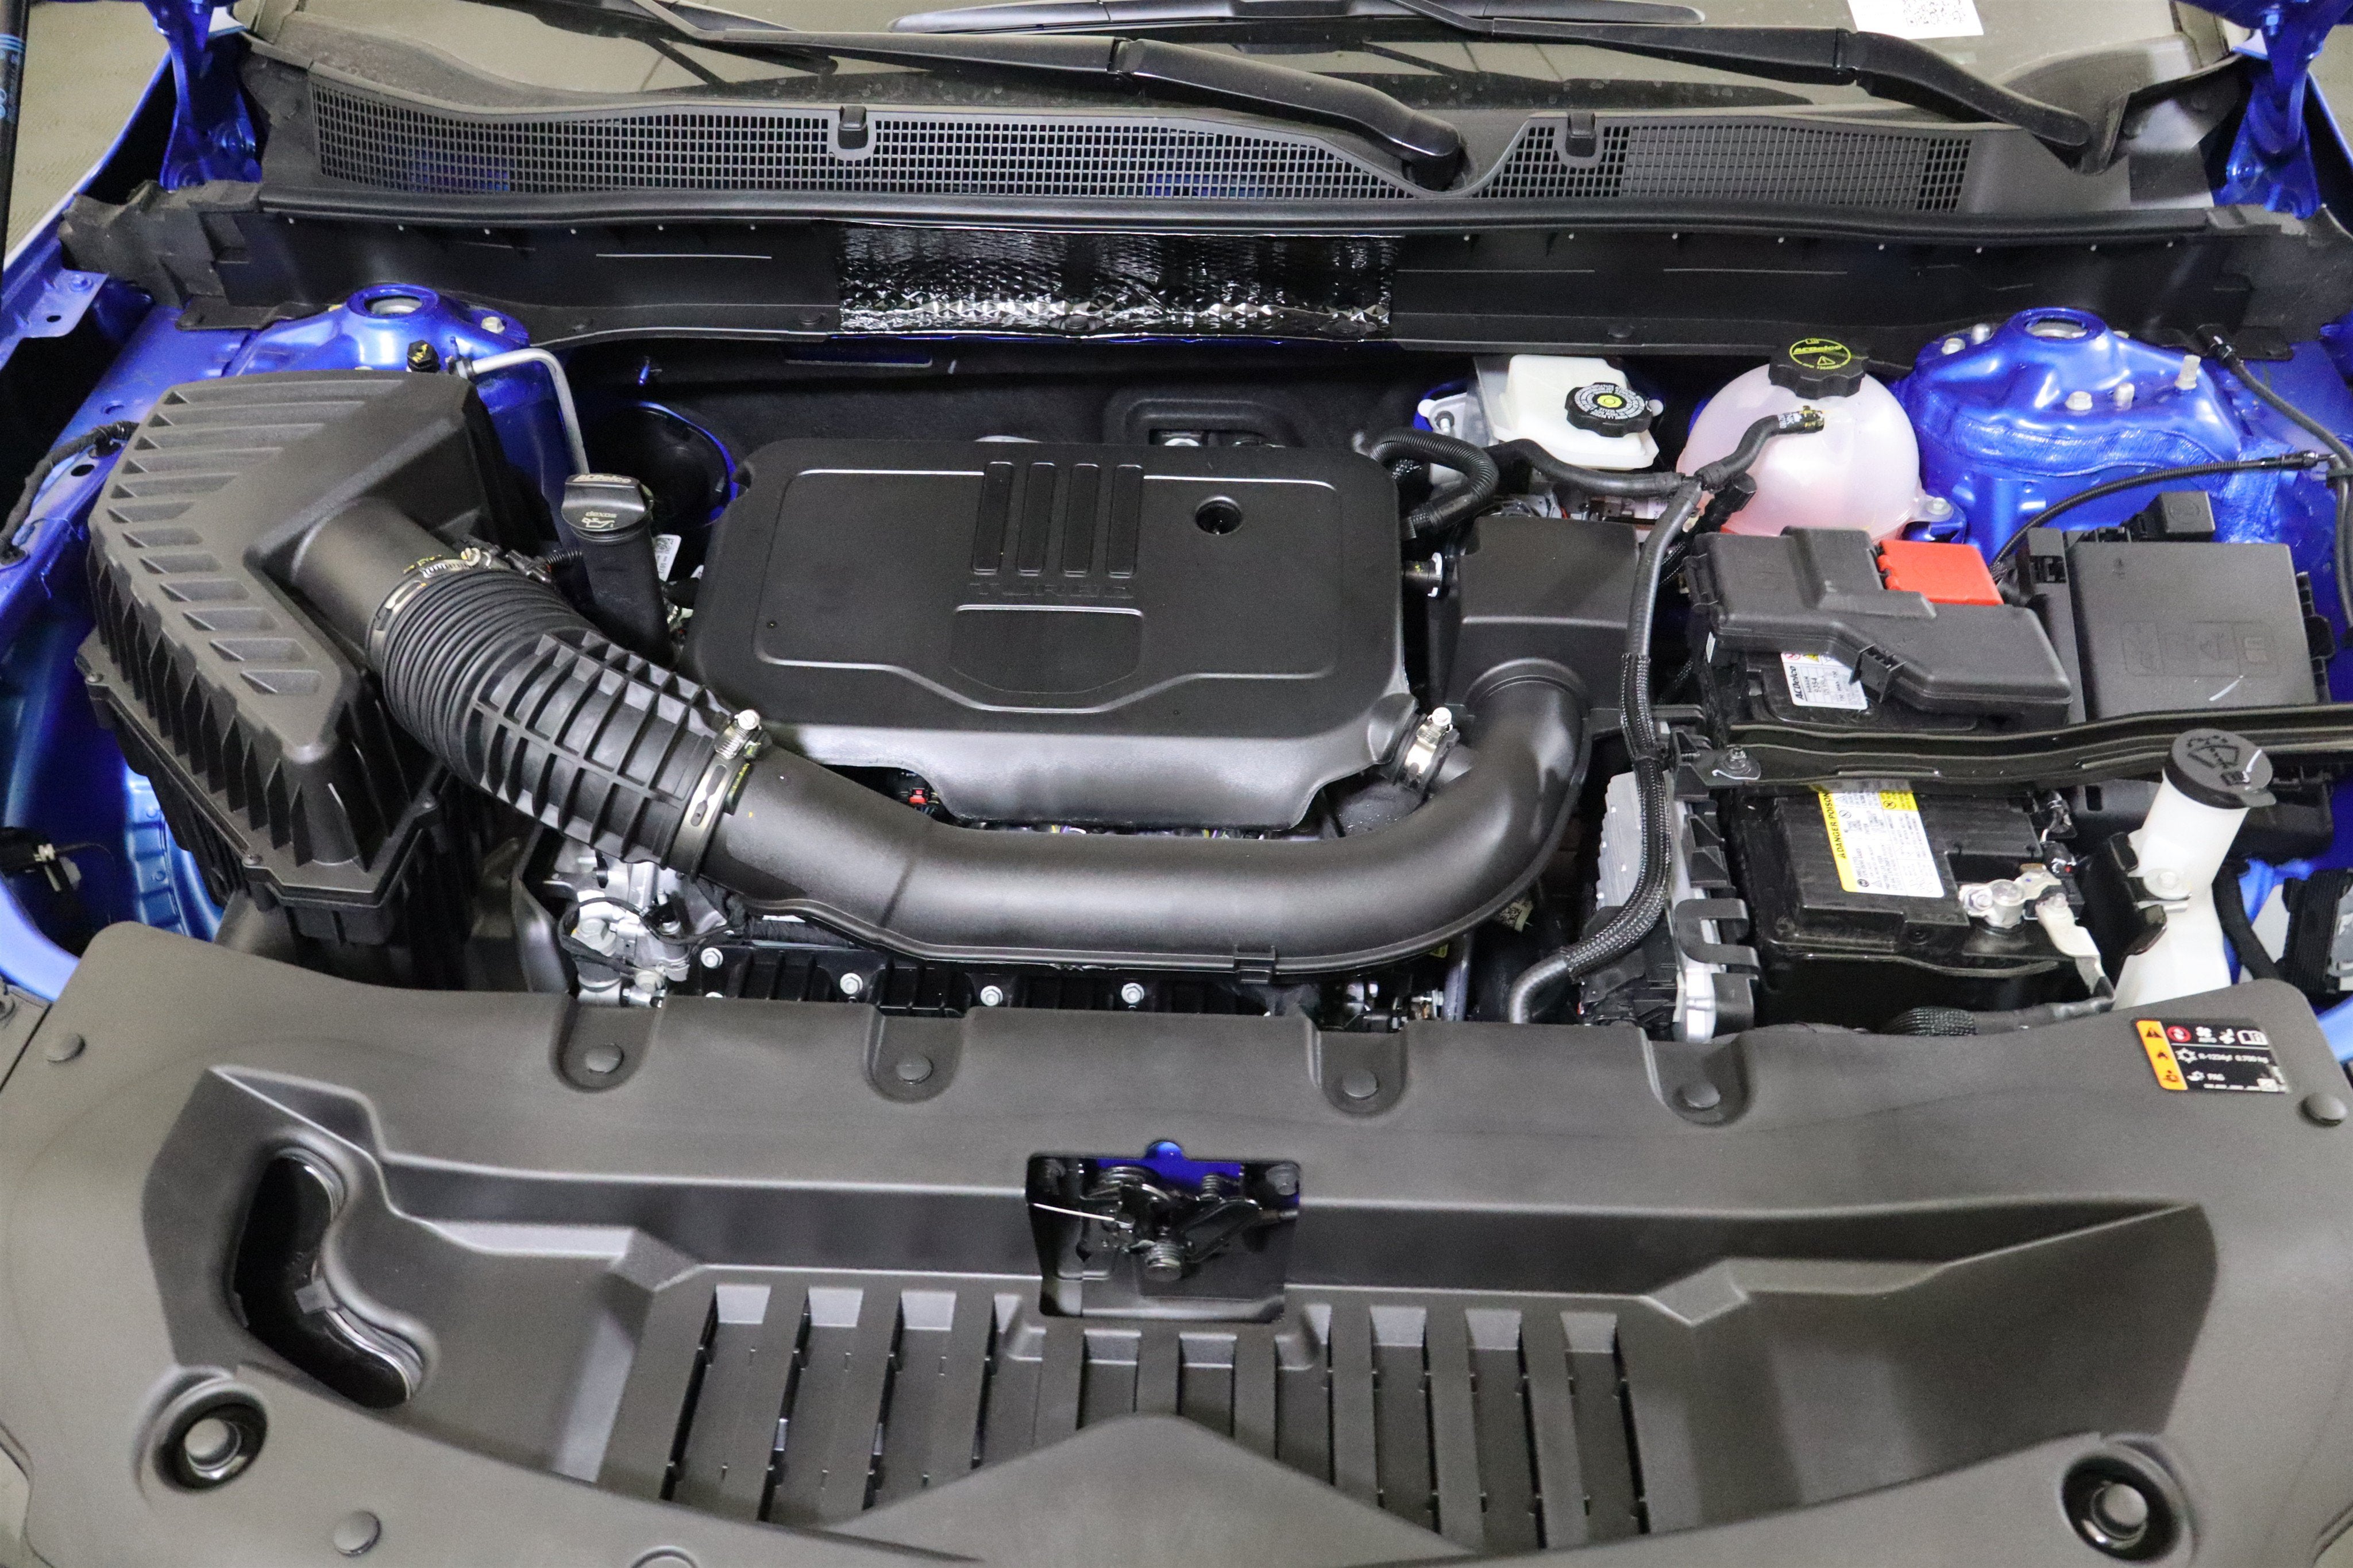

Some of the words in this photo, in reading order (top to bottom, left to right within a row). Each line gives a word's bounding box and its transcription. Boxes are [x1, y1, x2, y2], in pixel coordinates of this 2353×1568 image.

[572, 474, 631, 484] ACDelco
[1789, 666, 1804, 700] ACDelco
[1823, 792, 1837, 819] POISON
[1830, 821, 1844, 852] DANGER
